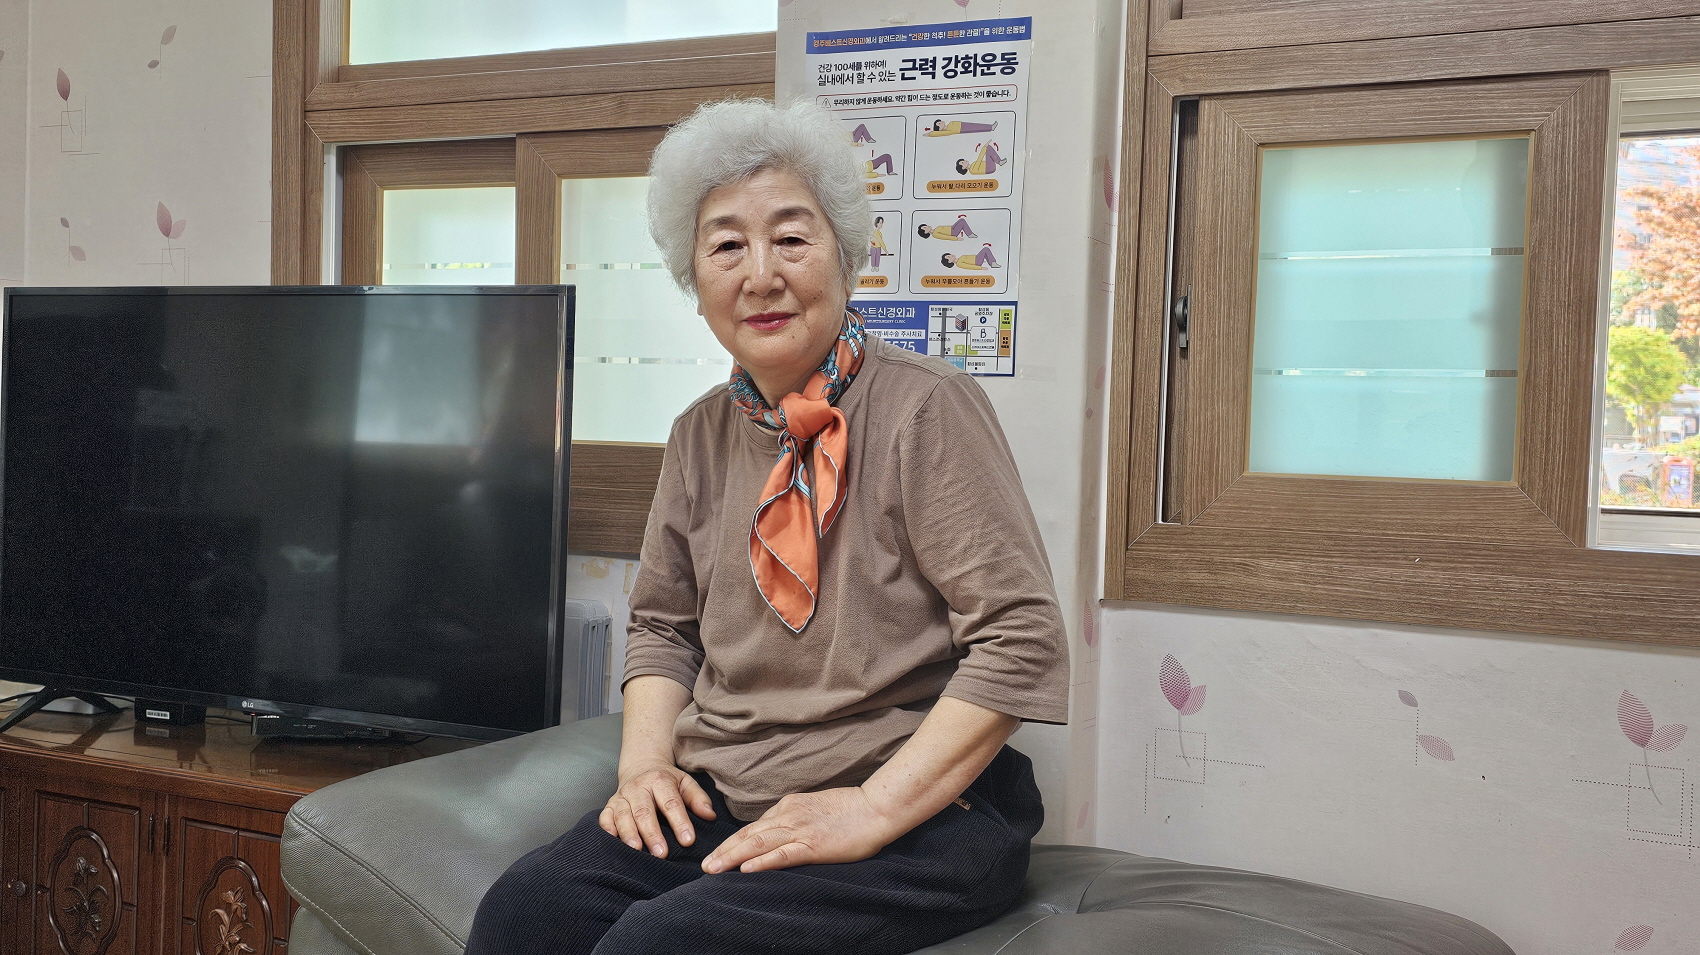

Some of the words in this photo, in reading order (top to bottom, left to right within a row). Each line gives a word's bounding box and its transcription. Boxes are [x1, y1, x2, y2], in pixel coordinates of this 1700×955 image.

[991, 26, 1005, 35] 위한
[1006, 25, 1026, 35] 운동법
[818, 63, 832, 73] 건강
[833, 61, 862, 72] 100세를
[863, 59, 887, 70] 위하여!
[899, 56, 937, 81] 근력
[941, 52, 1019, 79] 강화운동
[817, 73, 854, 86] 실내에서
[856, 72, 865, 84] 할
[867, 71, 876, 83] 수
[878, 70, 896, 82] 있는
[833, 98, 855, 106] 무리하지
[855, 96, 867, 105] 않게
[895, 94, 907, 103] 약간
[907, 93, 919, 102] 힘이
[919, 93, 931, 102] 드는
[932, 92, 949, 101] 정도로
[950, 91, 973, 100] 운동하는
[973, 90, 985, 99] 것이
[853, 306, 916, 318] 스트신경외과
